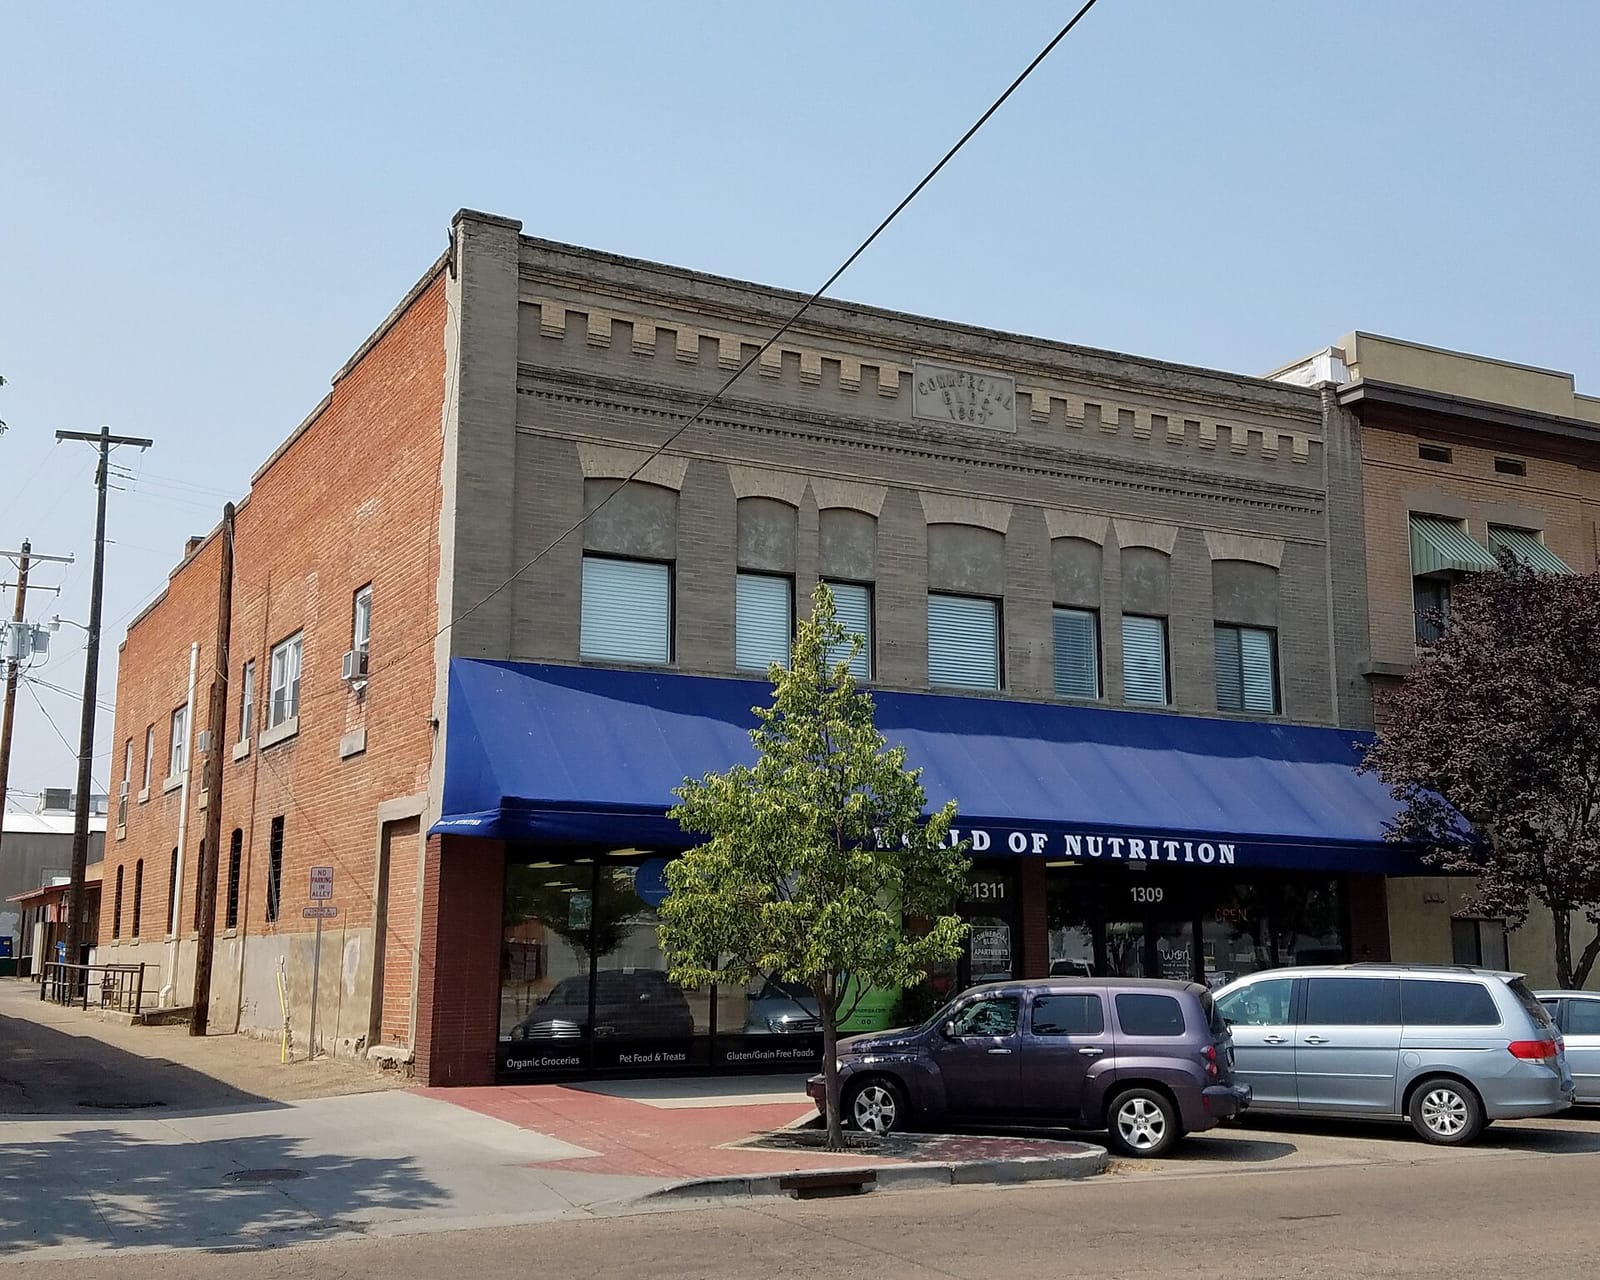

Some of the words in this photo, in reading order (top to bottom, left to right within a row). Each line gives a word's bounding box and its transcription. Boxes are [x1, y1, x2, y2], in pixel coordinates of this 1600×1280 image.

[1008, 831, 1048, 854] OF
[1064, 834, 1236, 865] NUTRITION
[317, 869, 327, 877] NO
[972, 882, 1005, 899] 1311
[1130, 887, 1164, 902] 1309
[1215, 907, 1248, 922] OPEN
[973, 930, 1008, 945] COMMERCIAL
[974, 948, 1009, 957] APARTMENTS
[619, 1054, 632, 1063] Pet
[633, 1053, 653, 1062] Food
[654, 1052, 662, 1062] &
[663, 1052, 686, 1061] Treats
[726, 1050, 775, 1061] Gluten/Grain
[776, 1049, 792, 1058] Free
[792, 1048, 815, 1057] Foods
[506, 1058, 540, 1070] Organic
[541, 1056, 580, 1066] Groceries
